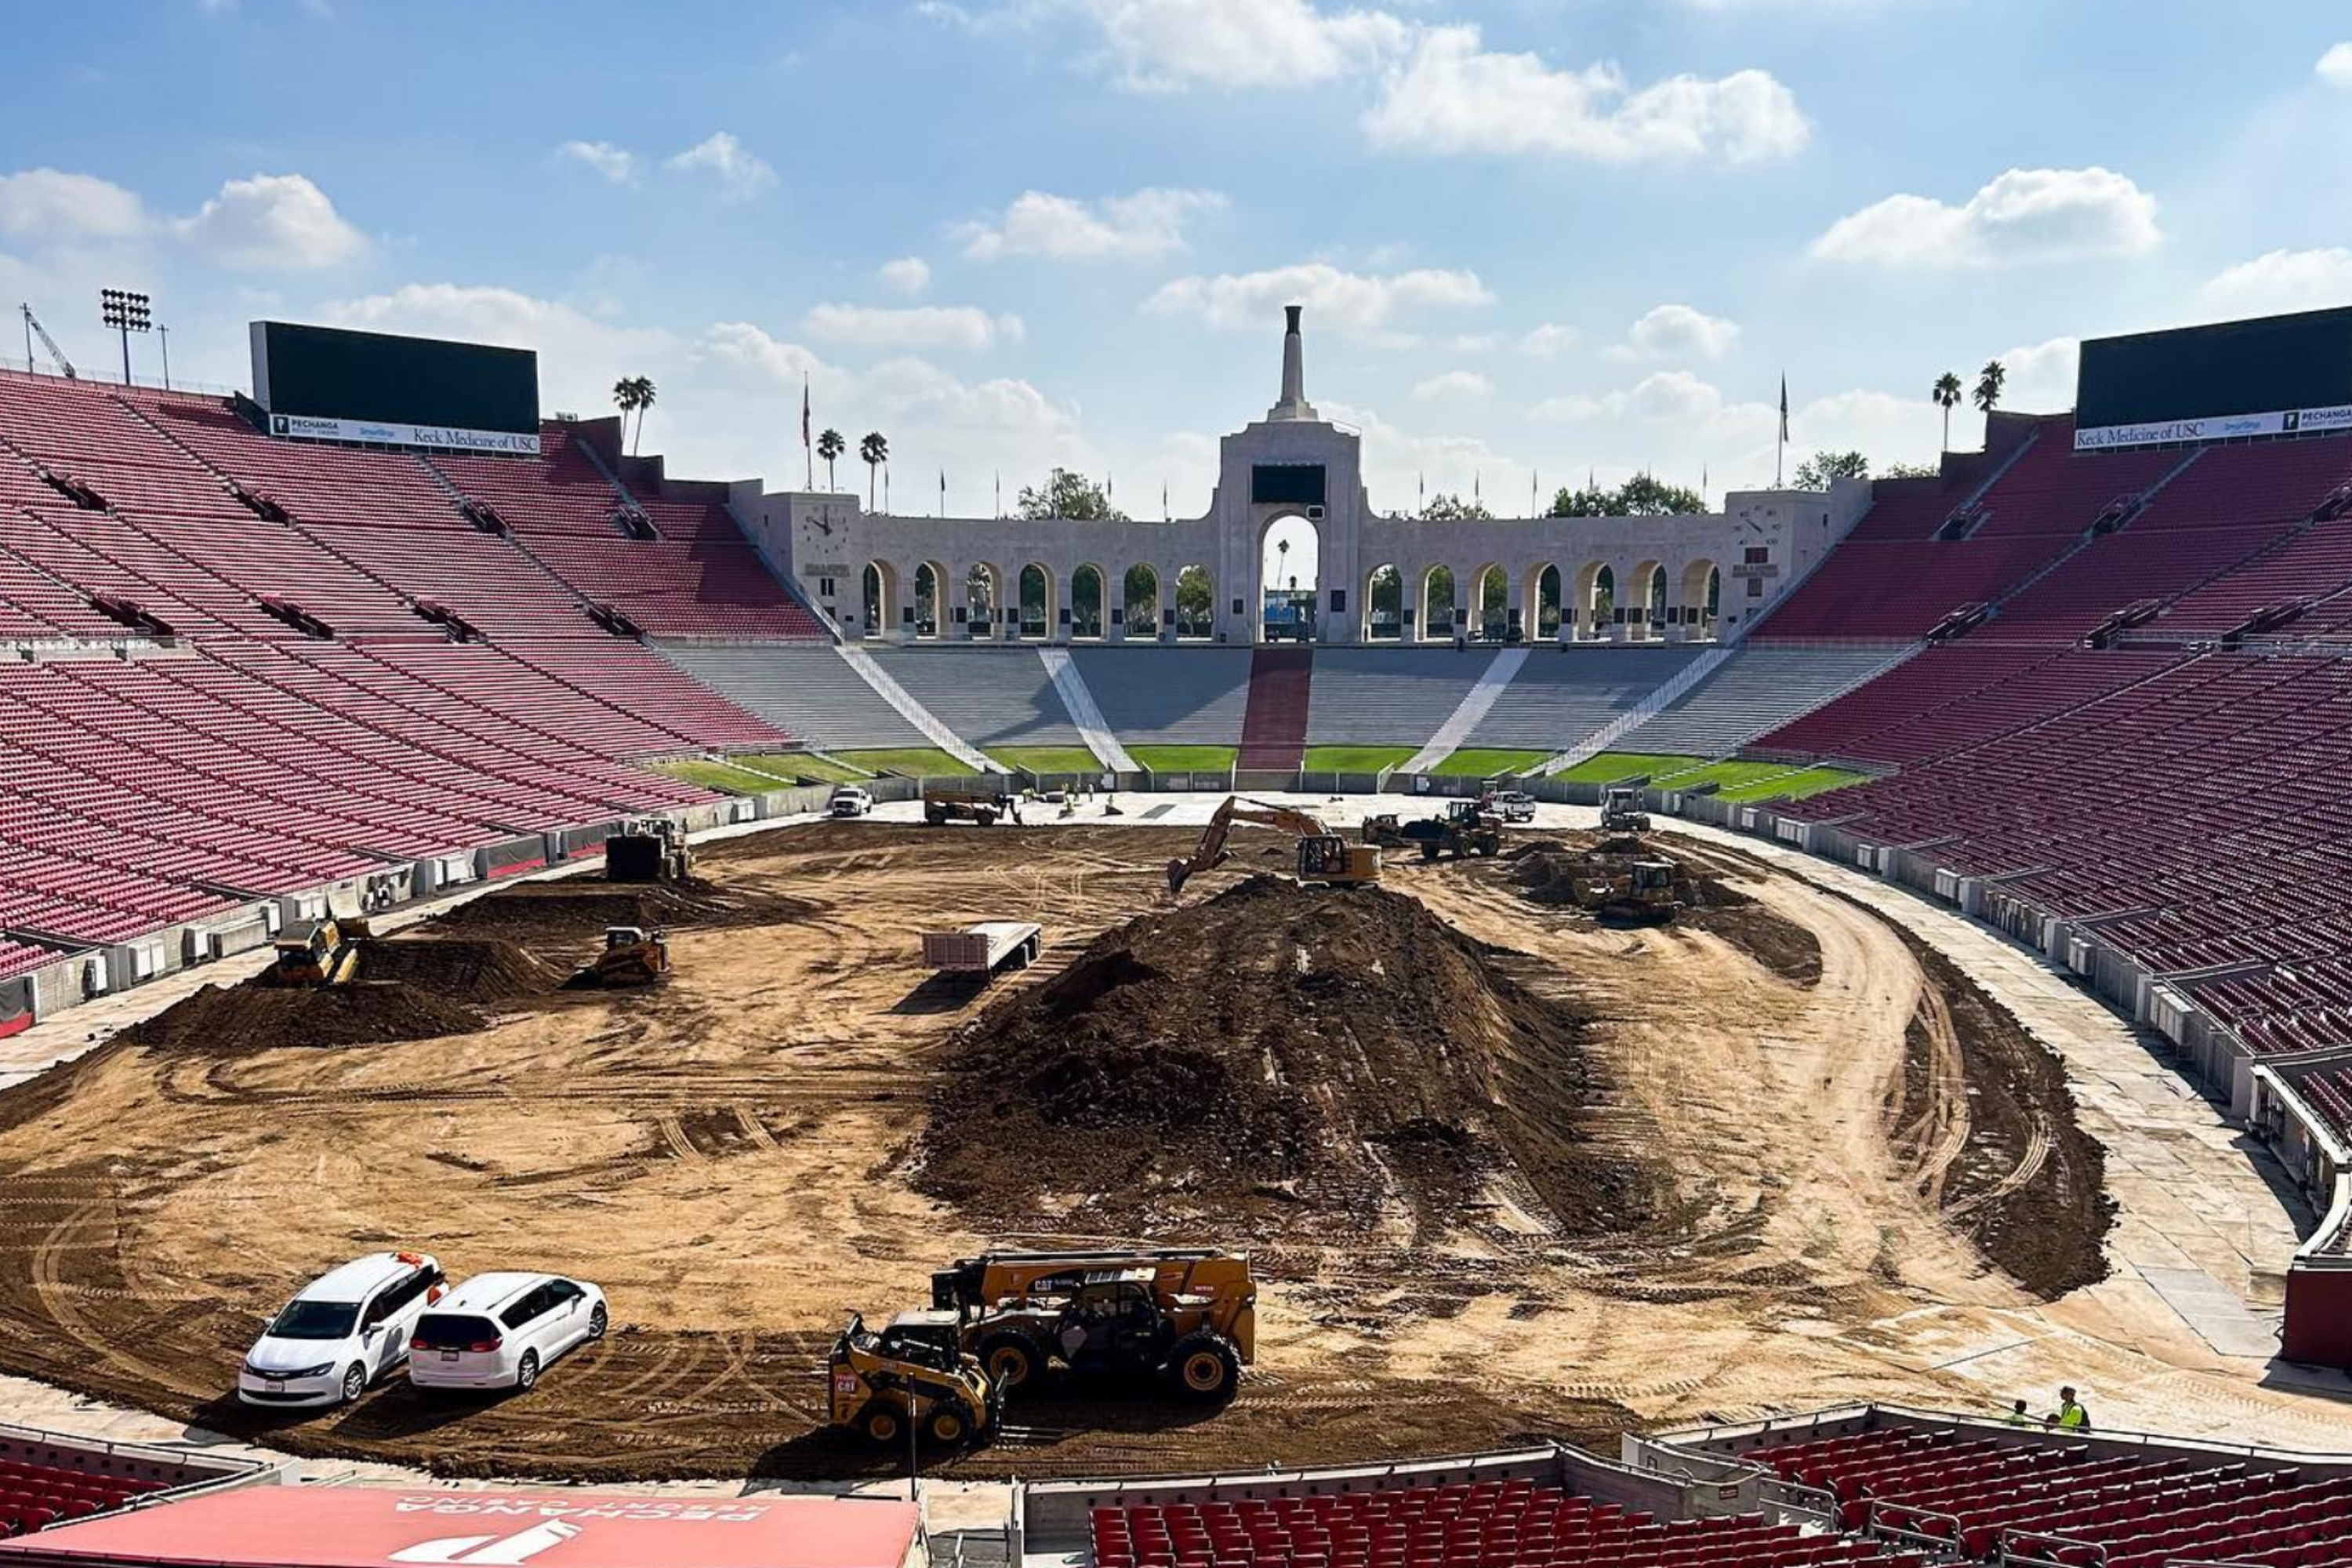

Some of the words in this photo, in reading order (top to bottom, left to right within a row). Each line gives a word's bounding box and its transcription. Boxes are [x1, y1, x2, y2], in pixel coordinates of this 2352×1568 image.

[2302, 409, 2352, 421] PECHANGA
[292, 419, 339, 429] PECHANGA
[414, 428, 443, 444] Keck
[446, 430, 497, 448] Medicine
[498, 435, 510, 449] of
[512, 436, 537, 451] USC
[2078, 430, 2104, 446] Keck
[2107, 427, 2159, 445] Medicine
[2160, 424, 2176, 439] of
[2176, 421, 2205, 439] USC
[1034, 1279, 1053, 1291] CAT
[838, 1381, 855, 1392] CAT
[395, 1501, 760, 1521] PECHANGA
